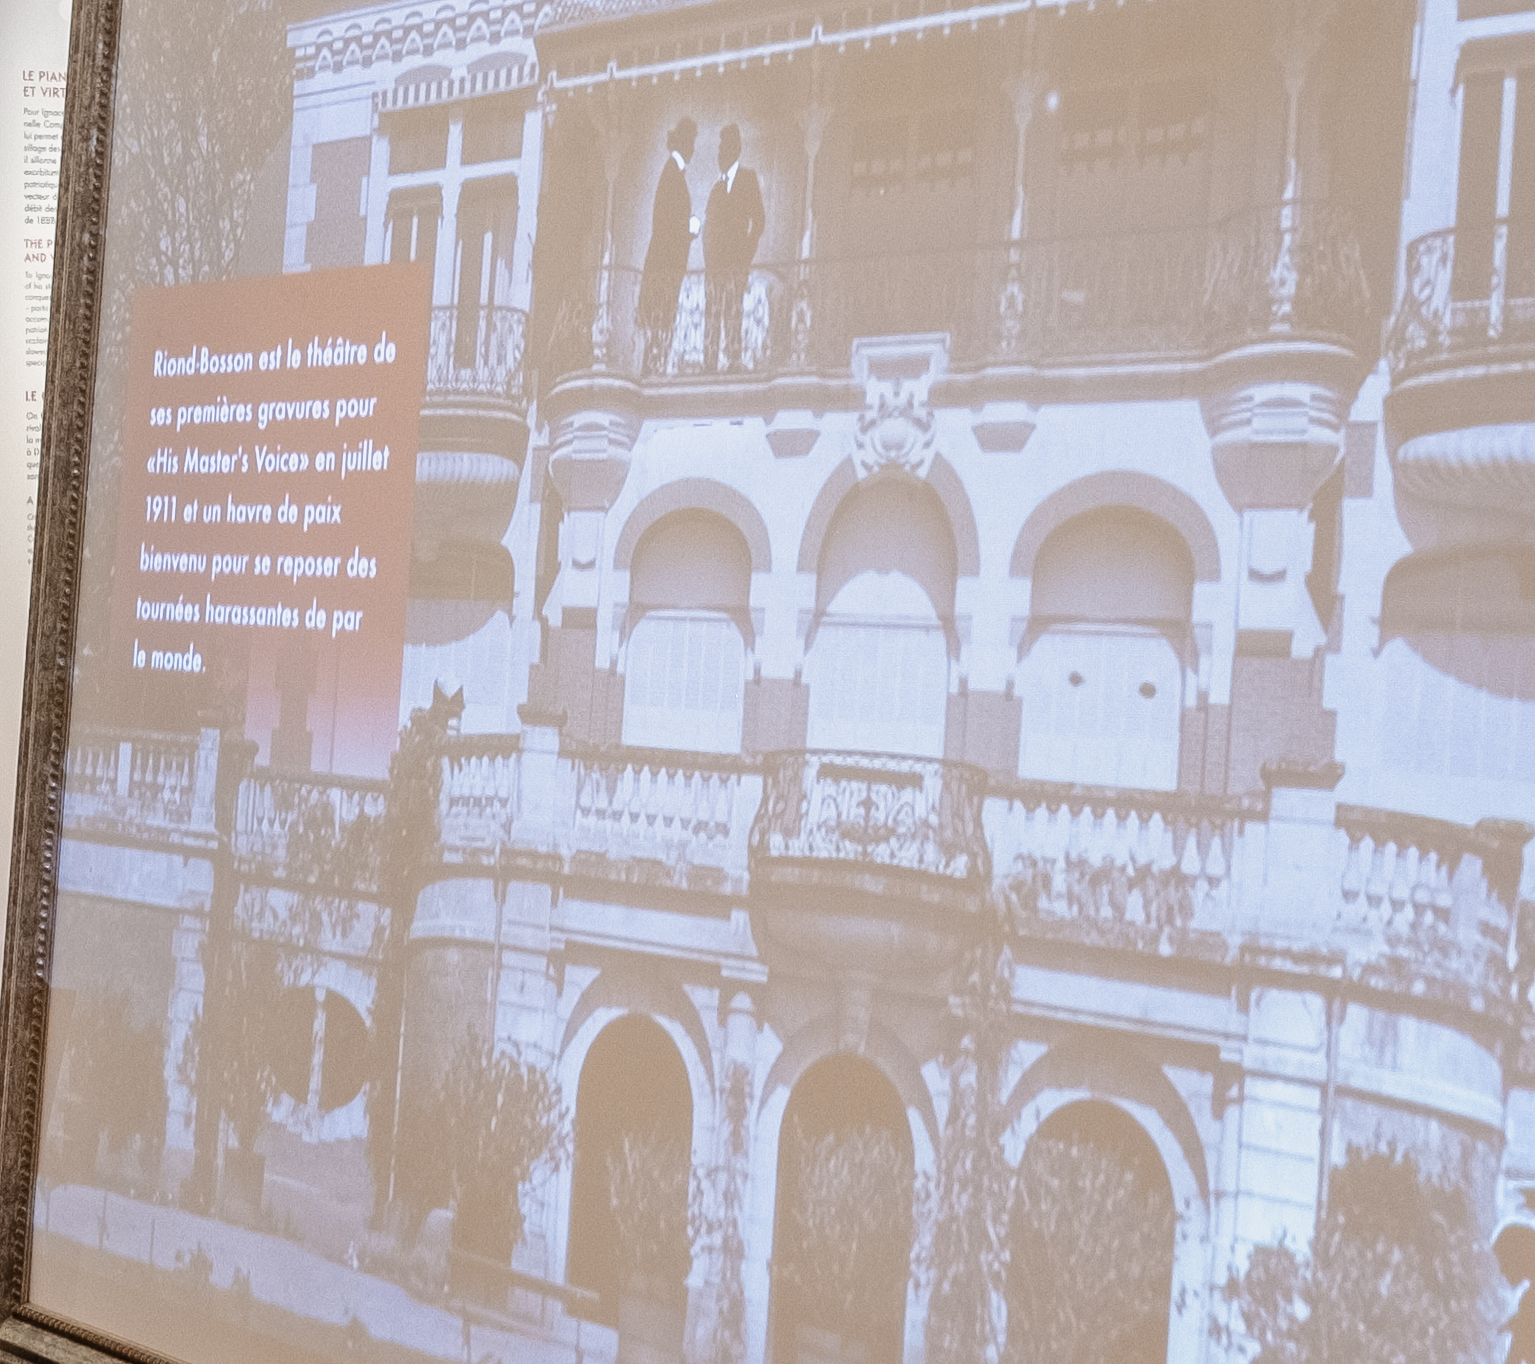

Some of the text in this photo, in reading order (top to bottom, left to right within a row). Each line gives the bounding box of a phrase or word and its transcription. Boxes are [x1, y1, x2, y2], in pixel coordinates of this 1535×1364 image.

[22, 70, 35, 81] LE
[23, 86, 36, 97] ET
[24, 238, 43, 249] THE
[24, 253, 47, 263] AND
[153, 330, 397, 378] Riond-Bosson est le théâtre de
[25, 391, 37, 402] LE
[149, 395, 378, 433] ses premières gravures pour
[183, 444, 249, 475] Master's
[314, 450, 336, 472] en
[340, 439, 390, 481] juillet
[146, 492, 342, 533] 1911 et un havre de paix
[139, 541, 377, 585] bienvenu pour se reposer des
[136, 593, 364, 640] tournées harassantes de par
[132, 638, 206, 673] le monde.
